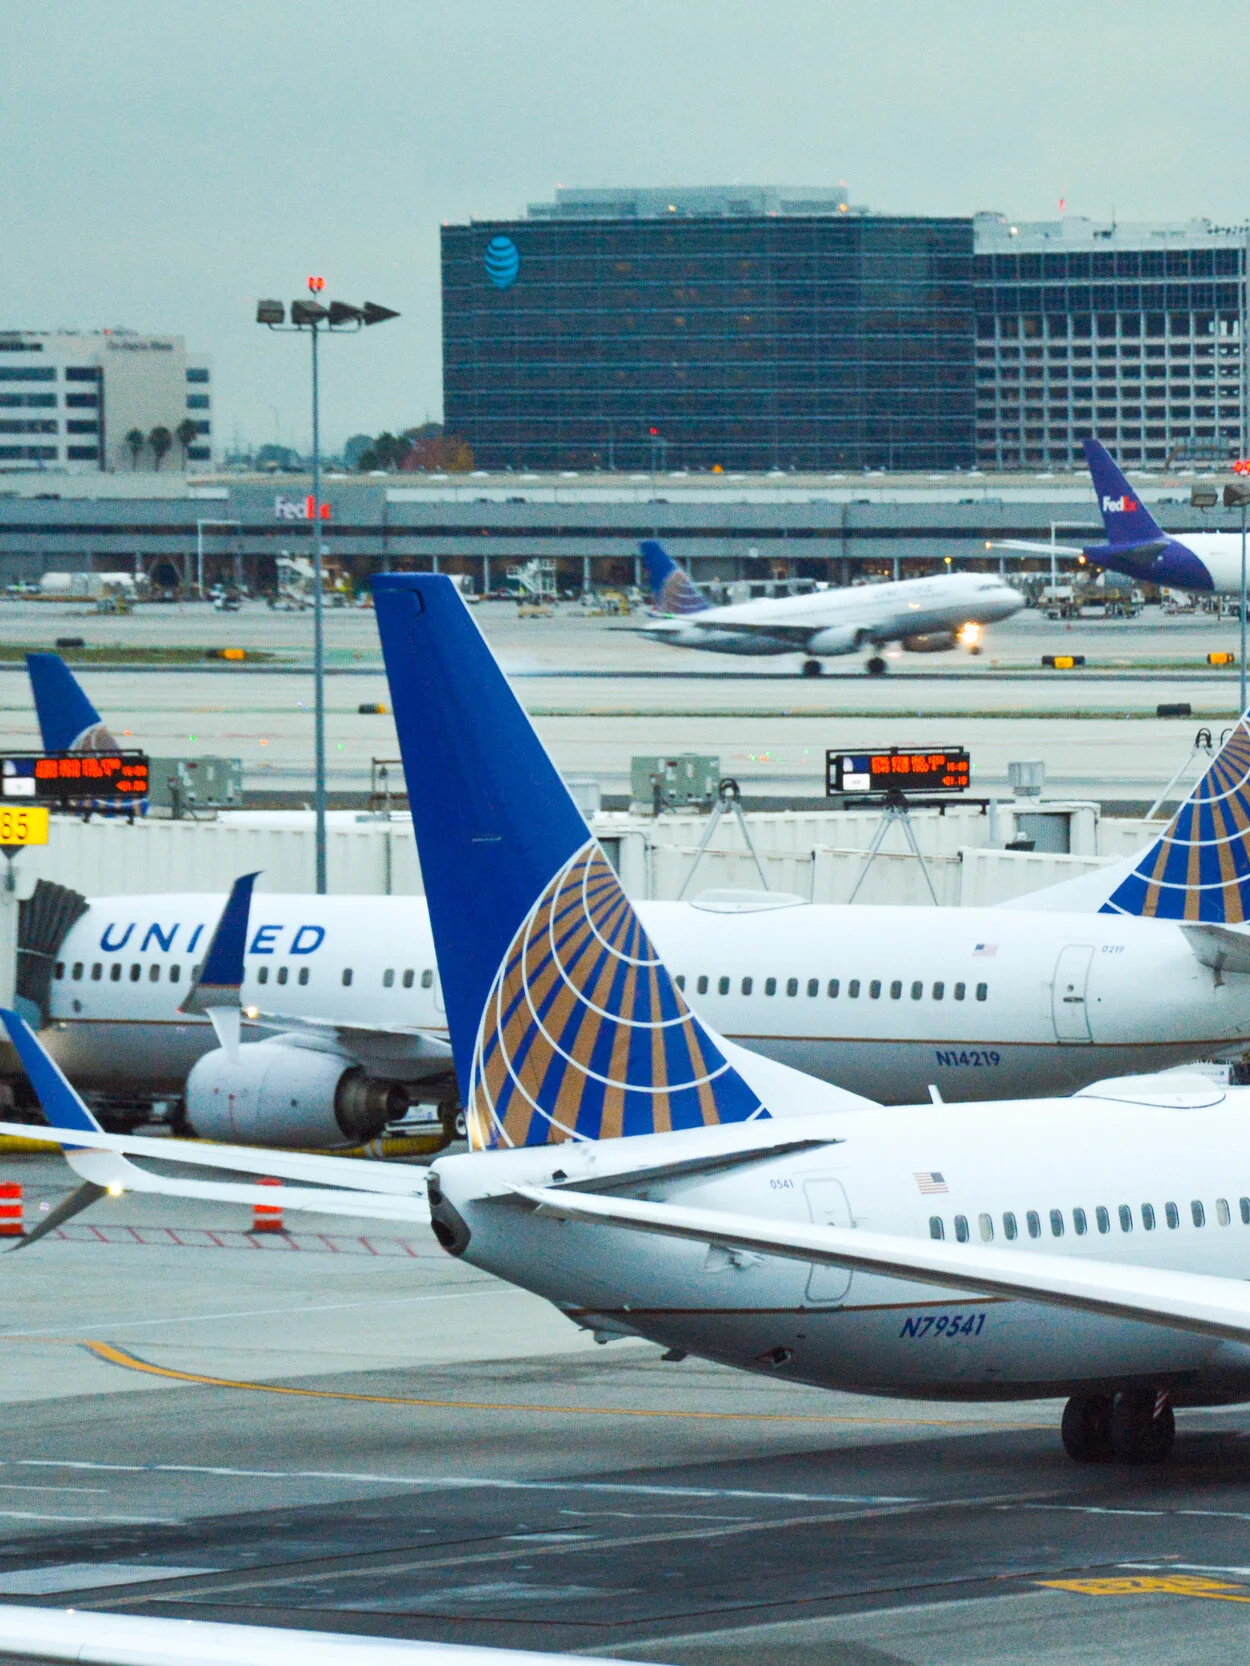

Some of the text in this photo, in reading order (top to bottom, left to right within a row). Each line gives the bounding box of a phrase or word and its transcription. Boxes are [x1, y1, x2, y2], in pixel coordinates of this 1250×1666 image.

[1, 812, 28, 840] 85
[100, 922, 326, 954] UNIED
[935, 1050, 1000, 1066] N14219
[899, 1313, 986, 1338] N79541
